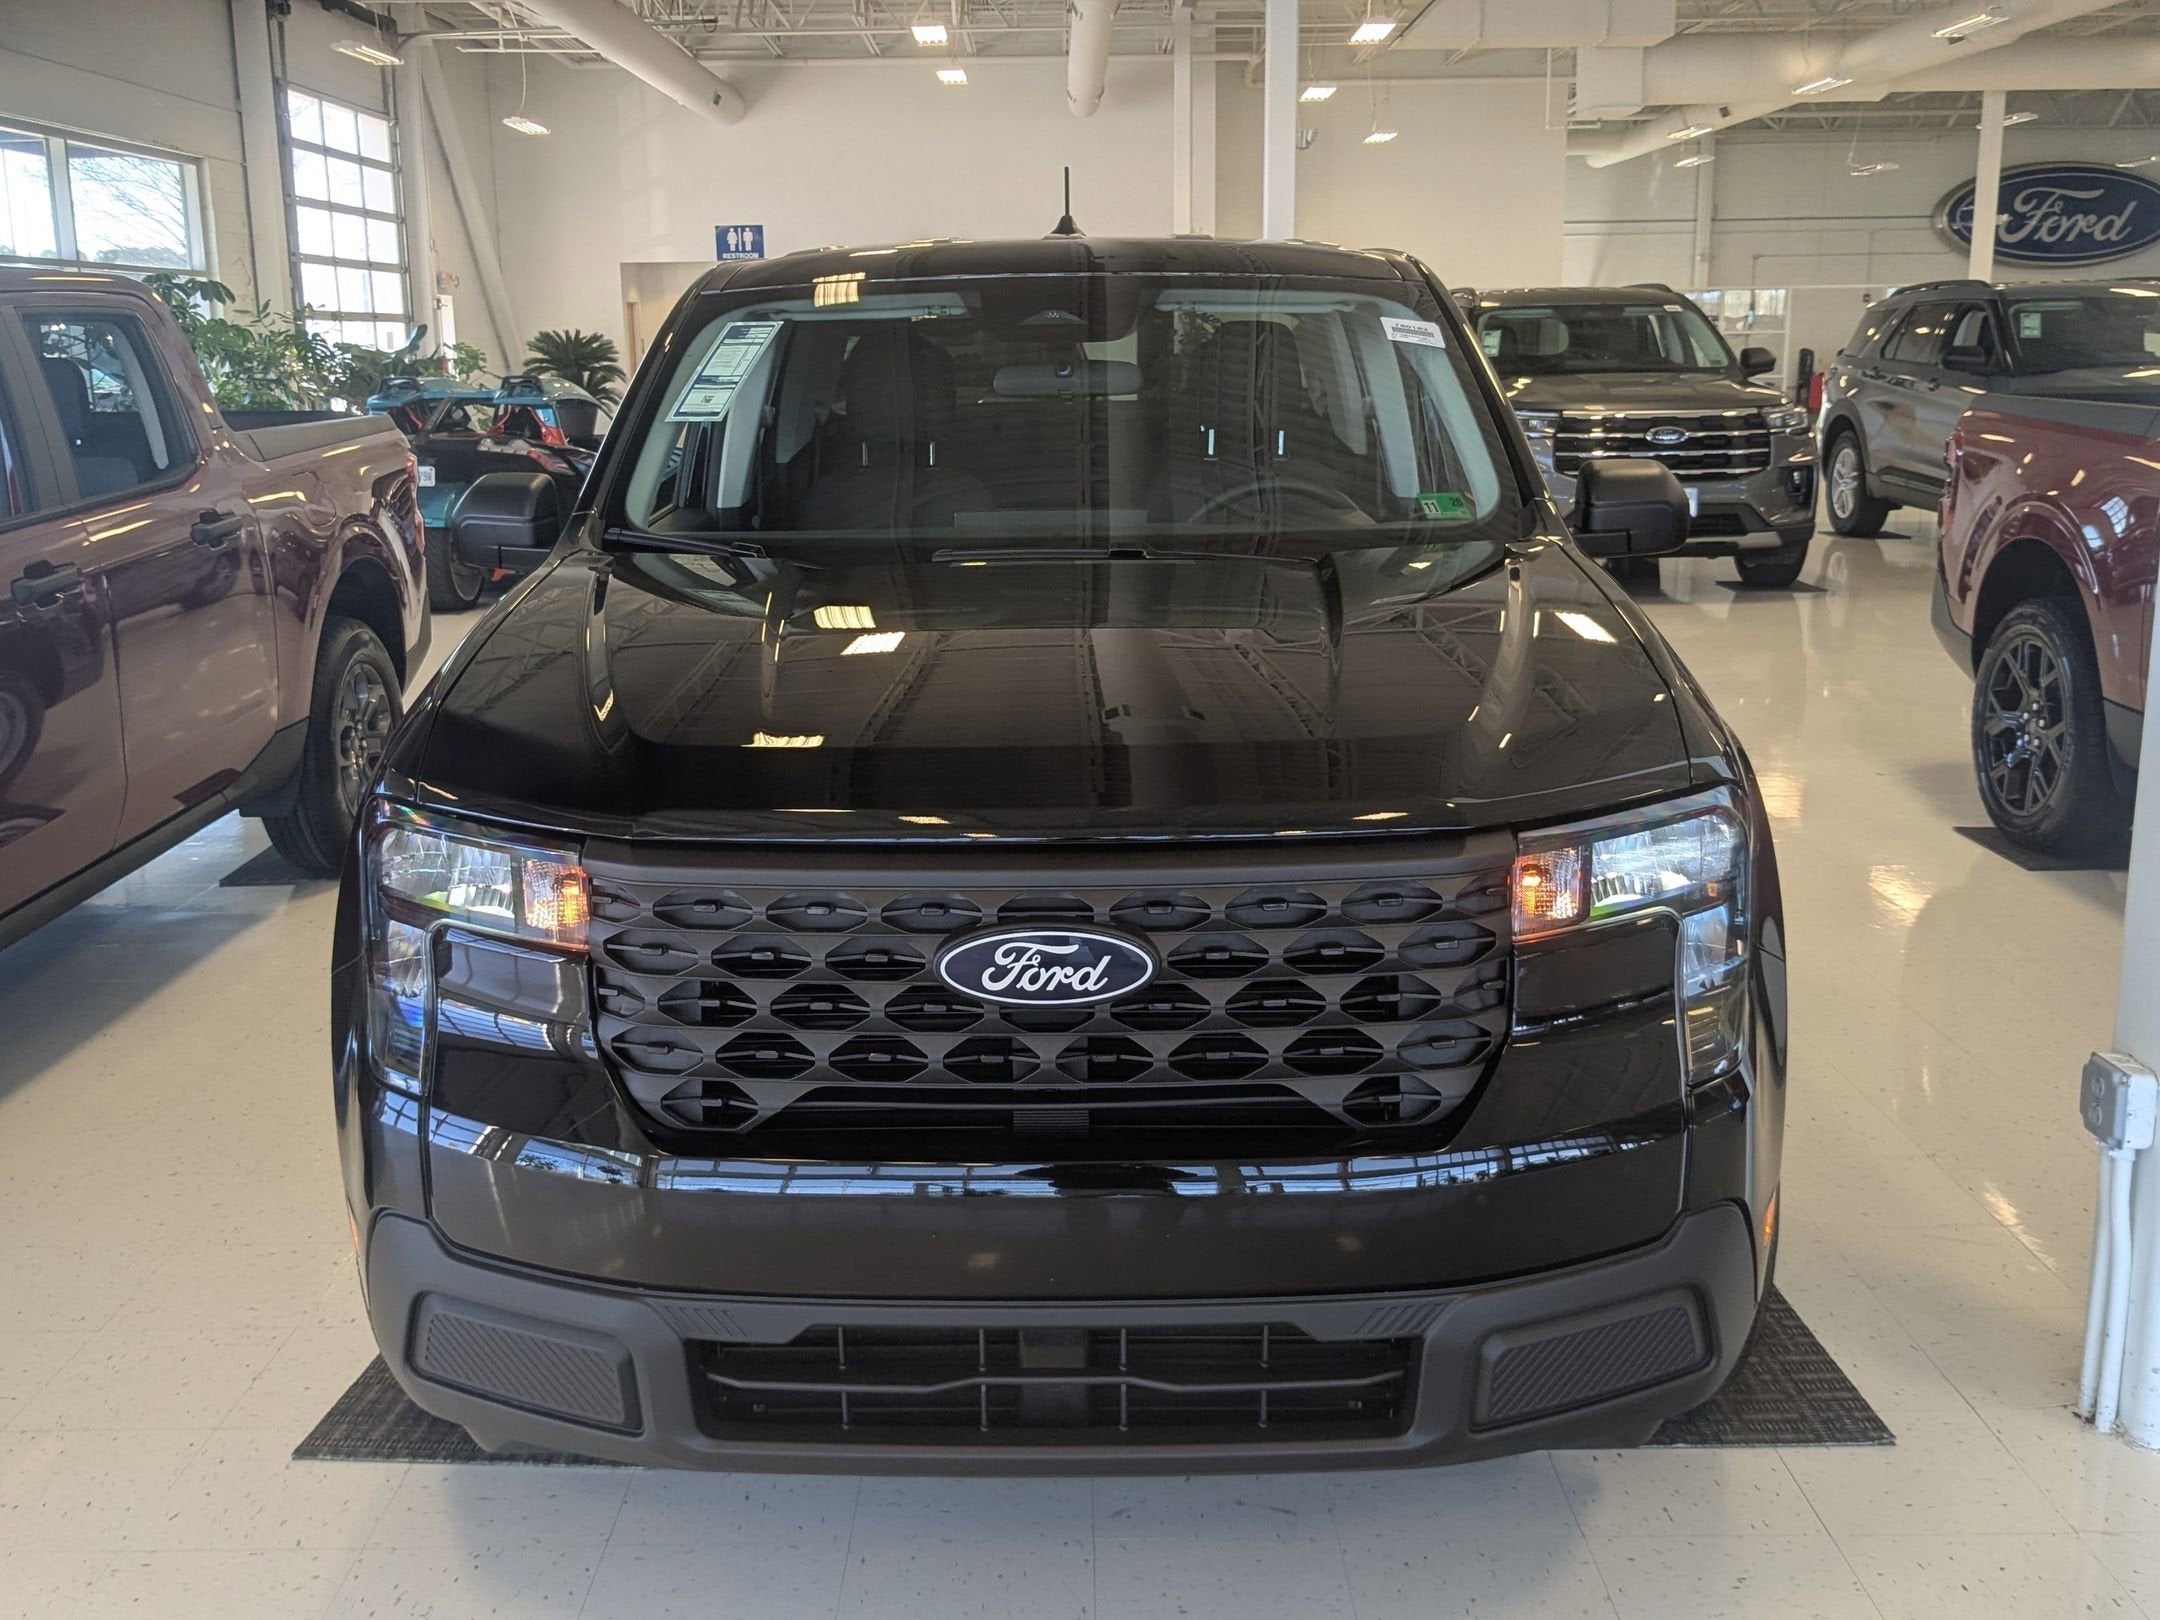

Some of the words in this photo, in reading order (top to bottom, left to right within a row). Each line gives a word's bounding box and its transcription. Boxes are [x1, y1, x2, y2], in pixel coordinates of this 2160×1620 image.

[2000, 188, 2136, 243] Ford
[722, 252, 760, 260] RESTROOM
[1423, 501, 1440, 513] 11
[982, 942, 1112, 991] Ford
